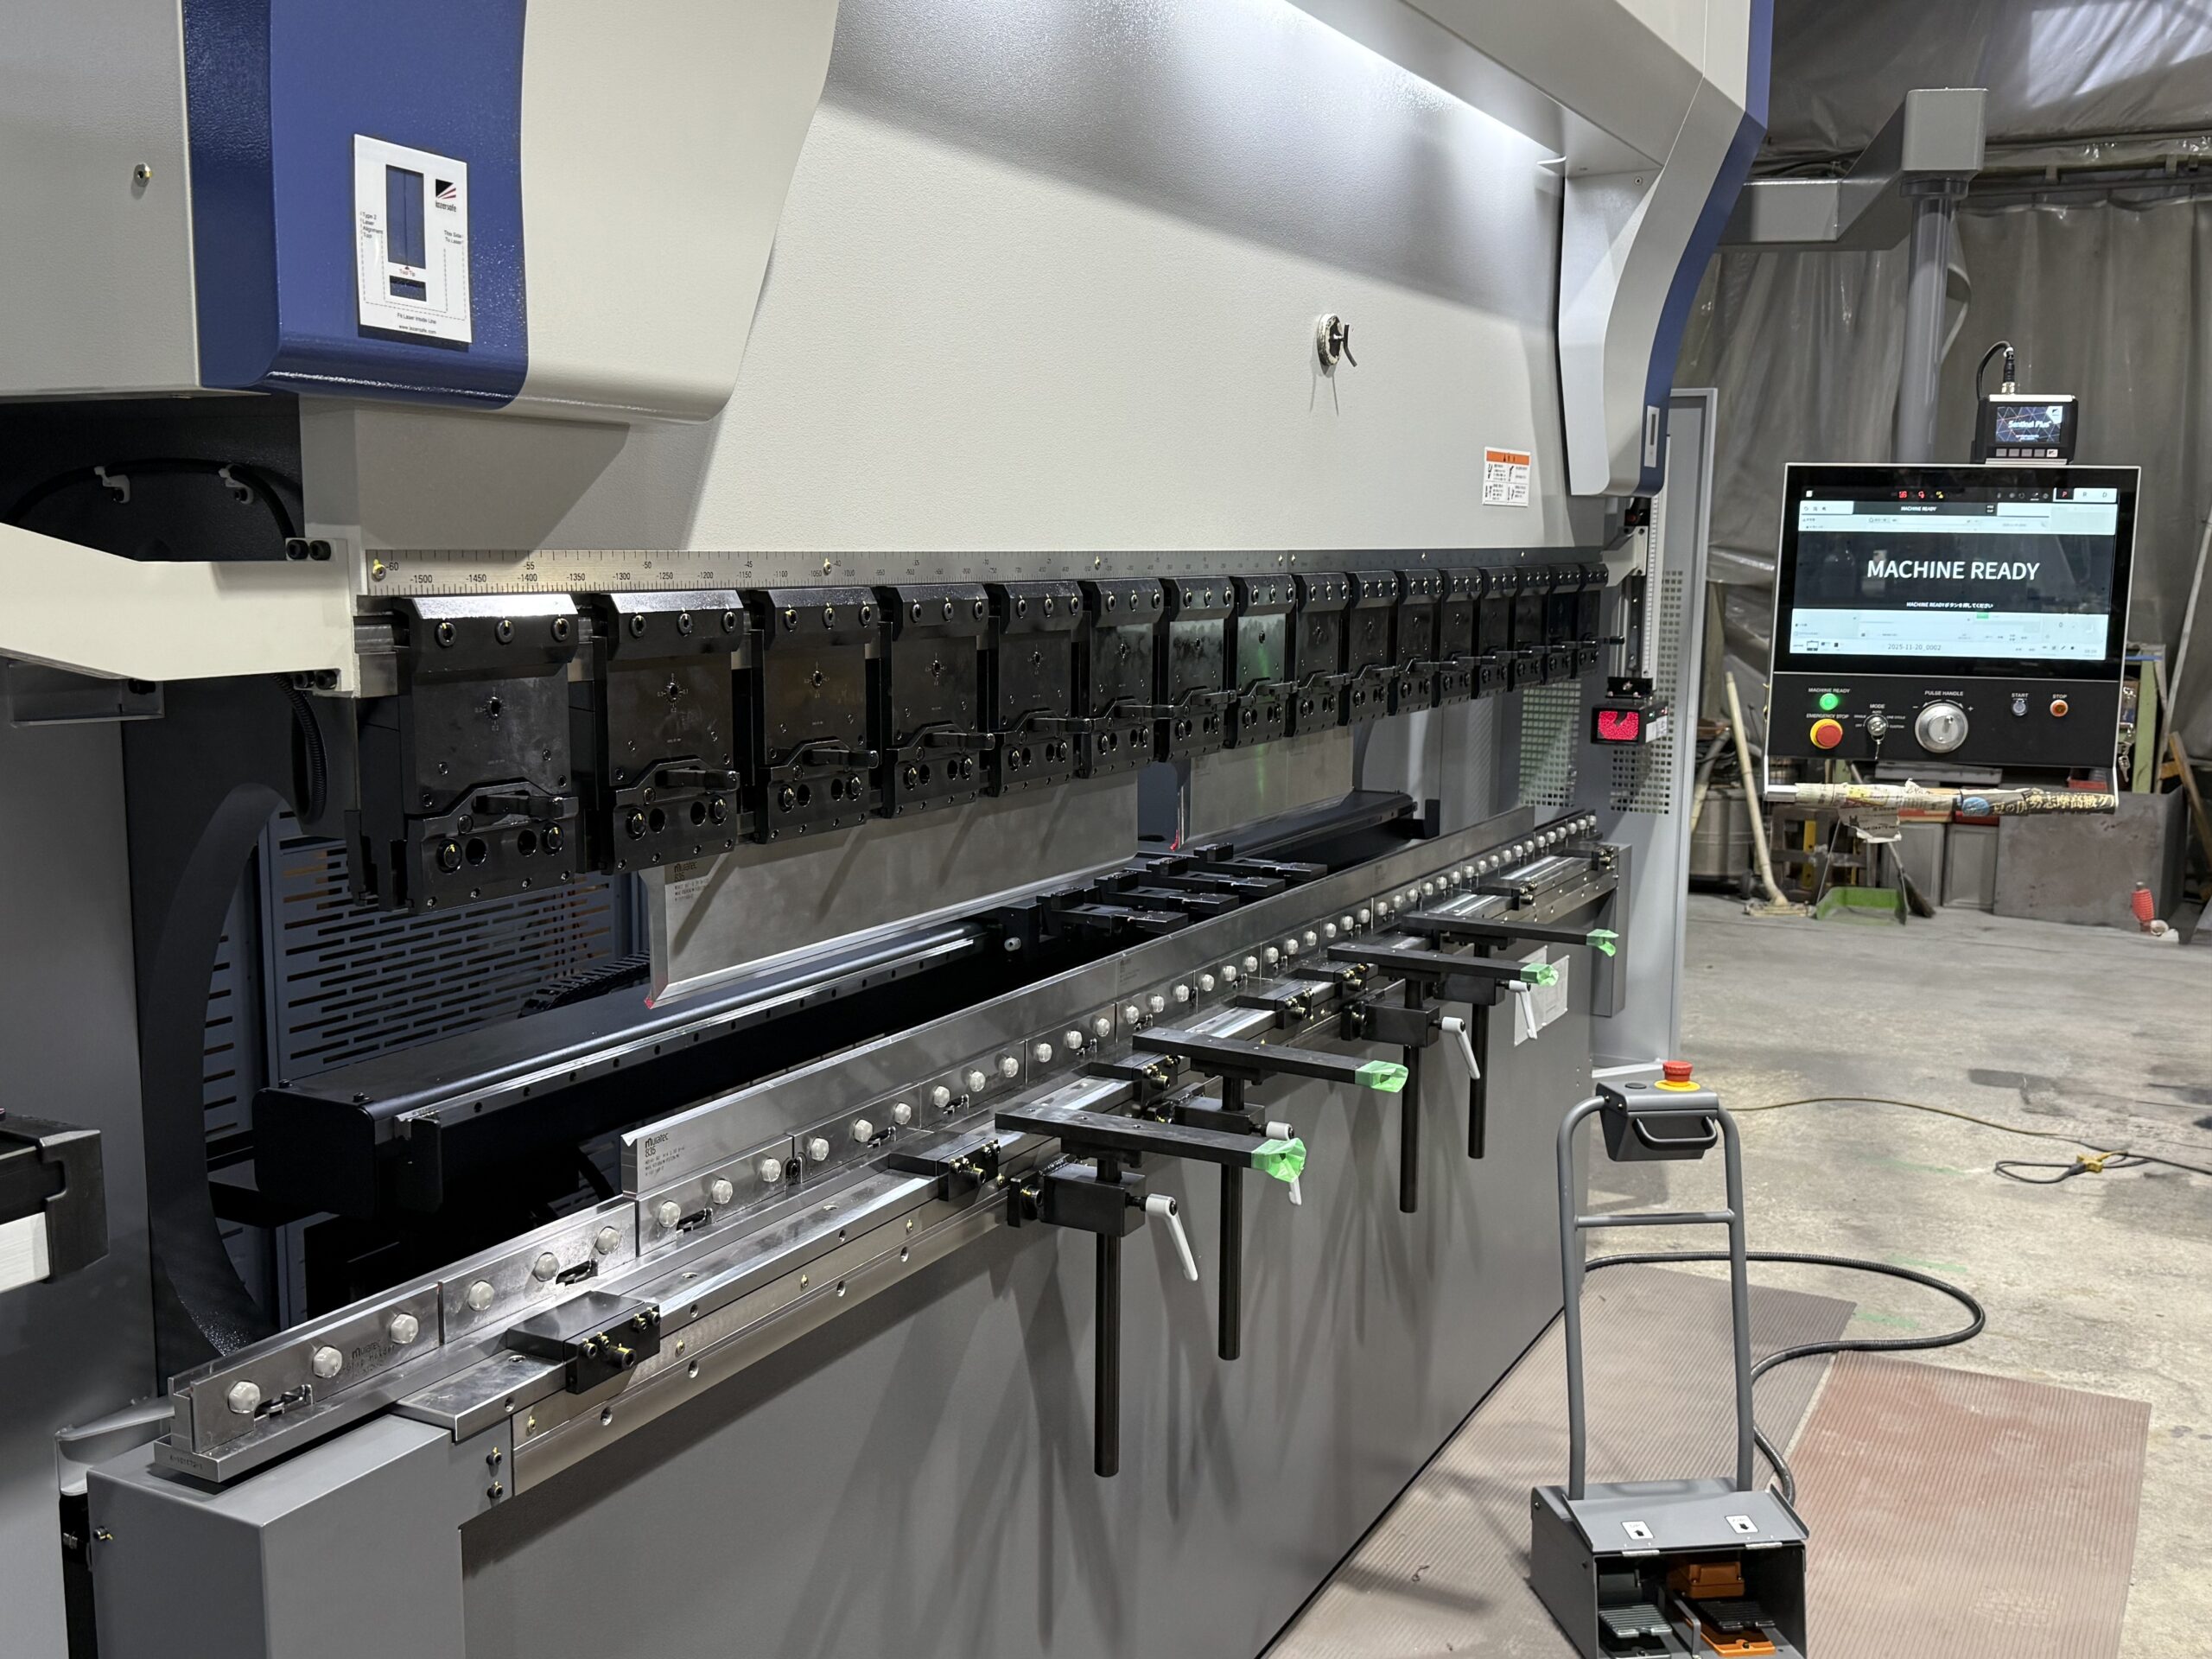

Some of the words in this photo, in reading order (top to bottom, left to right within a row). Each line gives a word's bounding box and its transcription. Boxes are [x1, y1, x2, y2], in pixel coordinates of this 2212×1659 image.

[386, 562, 399, 571] -60
[523, 562, 535, 570] -55
[1867, 560, 1965, 579] MACHINE
[1970, 562, 2040, 580] READY
[410, 574, 432, 583] -1500
[465, 574, 487, 583] -1450
[518, 573, 537, 582] -1400
[566, 572, 585, 581] -1350
[613, 572, 631, 580] -1300
[656, 572, 674, 580] -1250
[645, 1145, 656, 1158] 835
